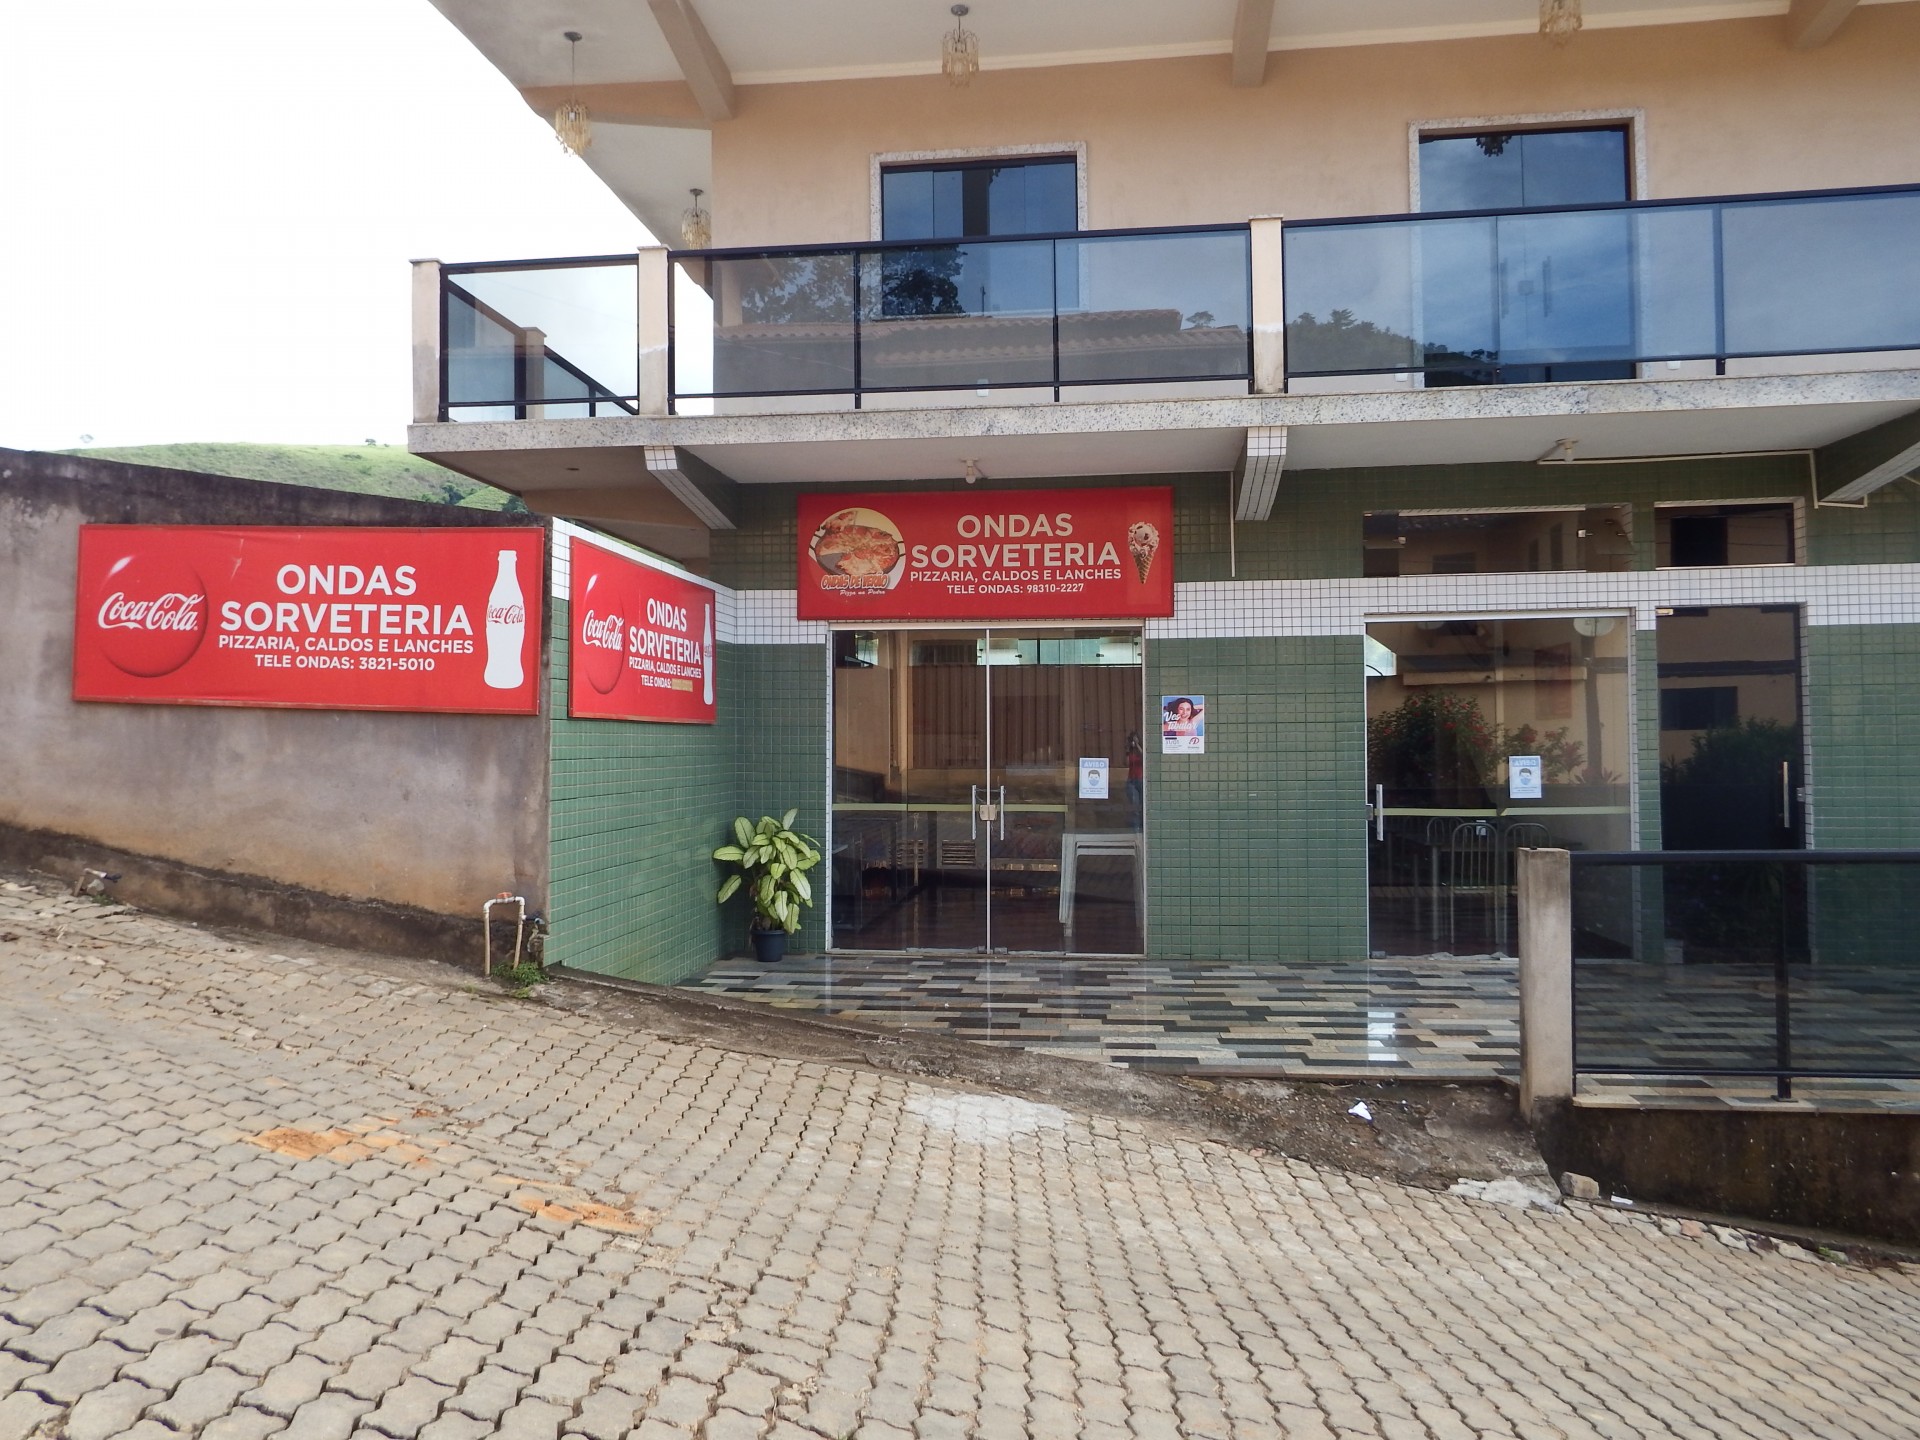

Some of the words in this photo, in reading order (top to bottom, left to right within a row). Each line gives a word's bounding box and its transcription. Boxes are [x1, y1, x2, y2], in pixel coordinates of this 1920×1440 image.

[958, 513, 1073, 538] ONDAS
[911, 541, 1121, 568] SORVETERIA
[276, 564, 417, 596] ONDAS
[910, 570, 978, 582] PIZZARIA,
[982, 569, 1039, 581] CALDOS
[1043, 569, 1052, 580] E
[1056, 568, 1121, 580] LANCHES
[946, 584, 976, 594] TELE
[979, 583, 1024, 594] ONDAS:
[1026, 582, 1084, 593] 98310-2227
[97, 591, 205, 631] Coca-Cola
[219, 601, 474, 635] SORVETERIA
[646, 597, 687, 632] ONDAS
[582, 609, 625, 652] Coca-Cola
[218, 635, 300, 653] PIZZARIA,
[304, 636, 374, 653] CALDOS
[378, 638, 389, 652] E
[393, 638, 474, 654] LANCHES
[628, 625, 702, 666] SORVETERIA
[254, 654, 292, 668] TELE
[296, 655, 355, 669] ONDAS:
[358, 657, 435, 671] 3821-5010
[628, 656, 656, 674] PIZZARIA,
[656, 661, 677, 676] CALDOS
[681, 664, 702, 679] LANCHES
[641, 674, 654, 687] TELE
[654, 675, 672, 689] ONDAS:
